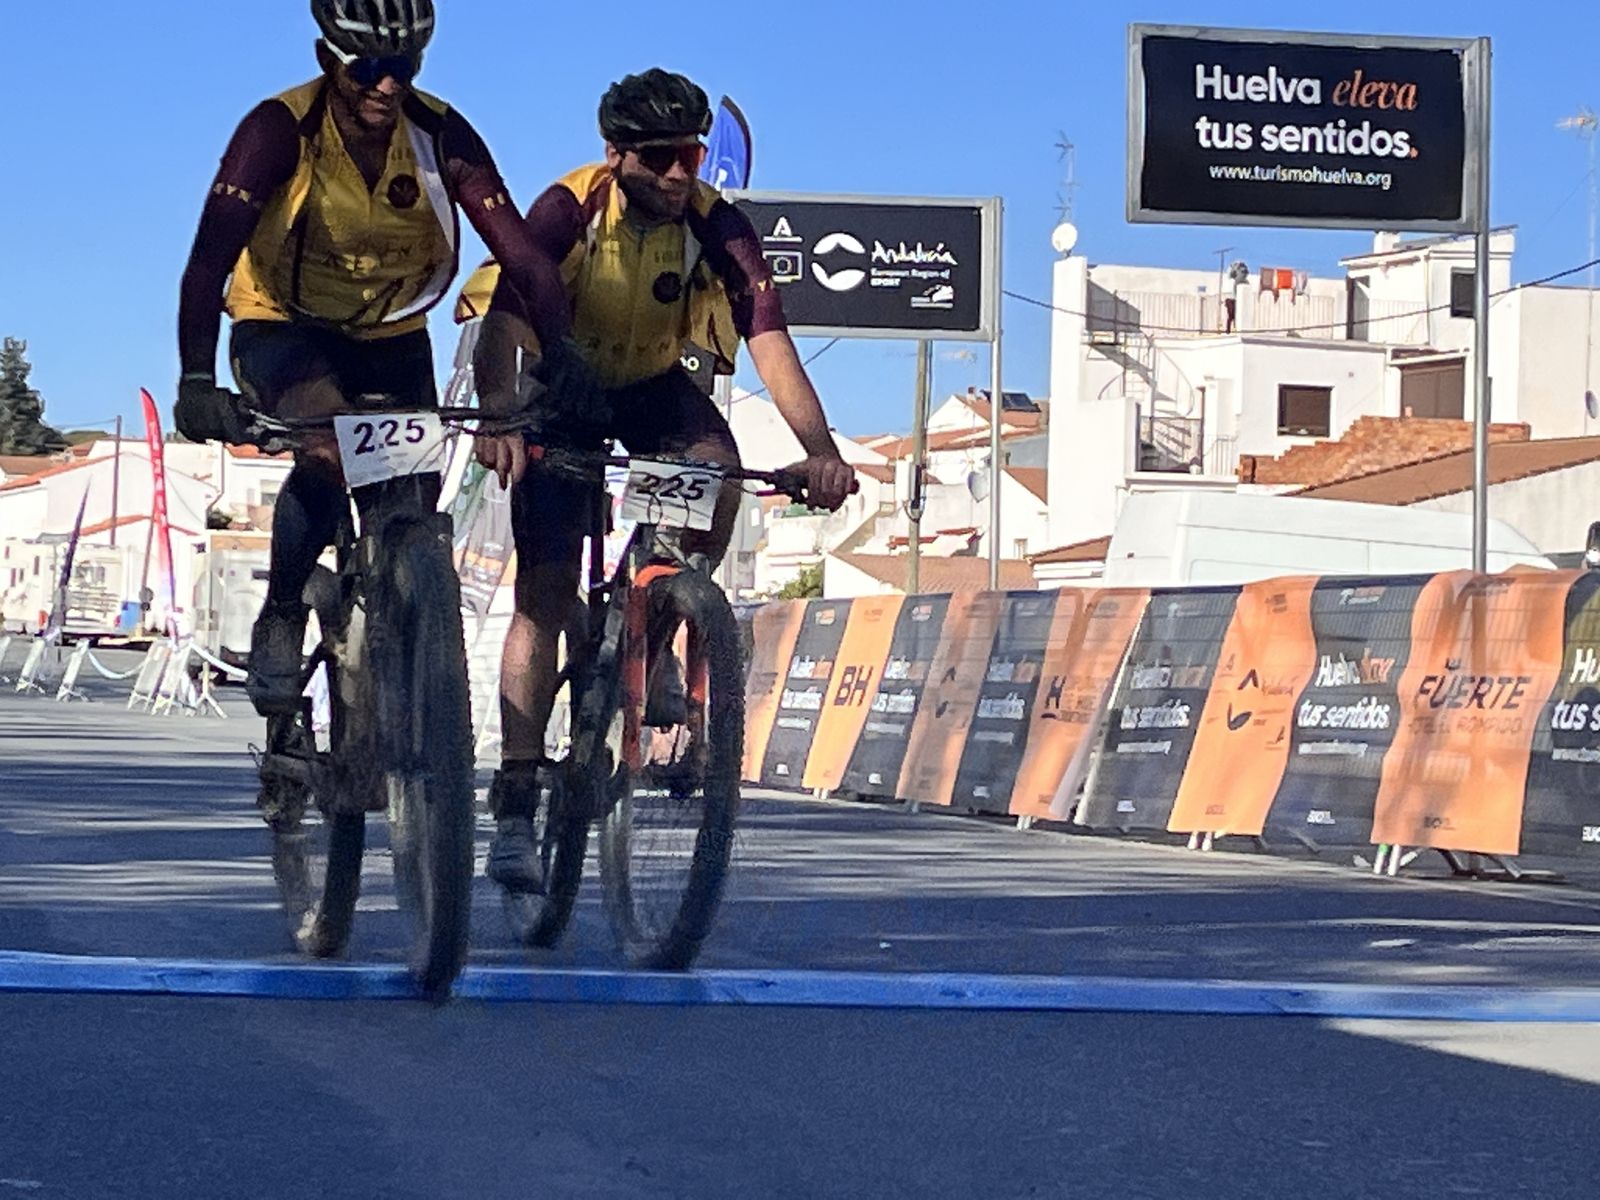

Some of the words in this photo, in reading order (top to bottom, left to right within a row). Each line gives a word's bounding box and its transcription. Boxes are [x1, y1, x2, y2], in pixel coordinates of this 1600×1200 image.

[1195, 64, 1322, 105] Huelva
[1332, 70, 1418, 111] eleva
[1195, 115, 1253, 151] tus
[1260, 119, 1419, 159] sentidos.
[1209, 163, 1392, 190] www.turismohuelva.org
[636, 474, 710, 501] 225
[834, 665, 873, 706] BH
[1415, 676, 1532, 710] FUERTE
[1297, 699, 1327, 728] tus
[1321, 696, 1391, 729] sentidos
[1551, 699, 1590, 731] tus
